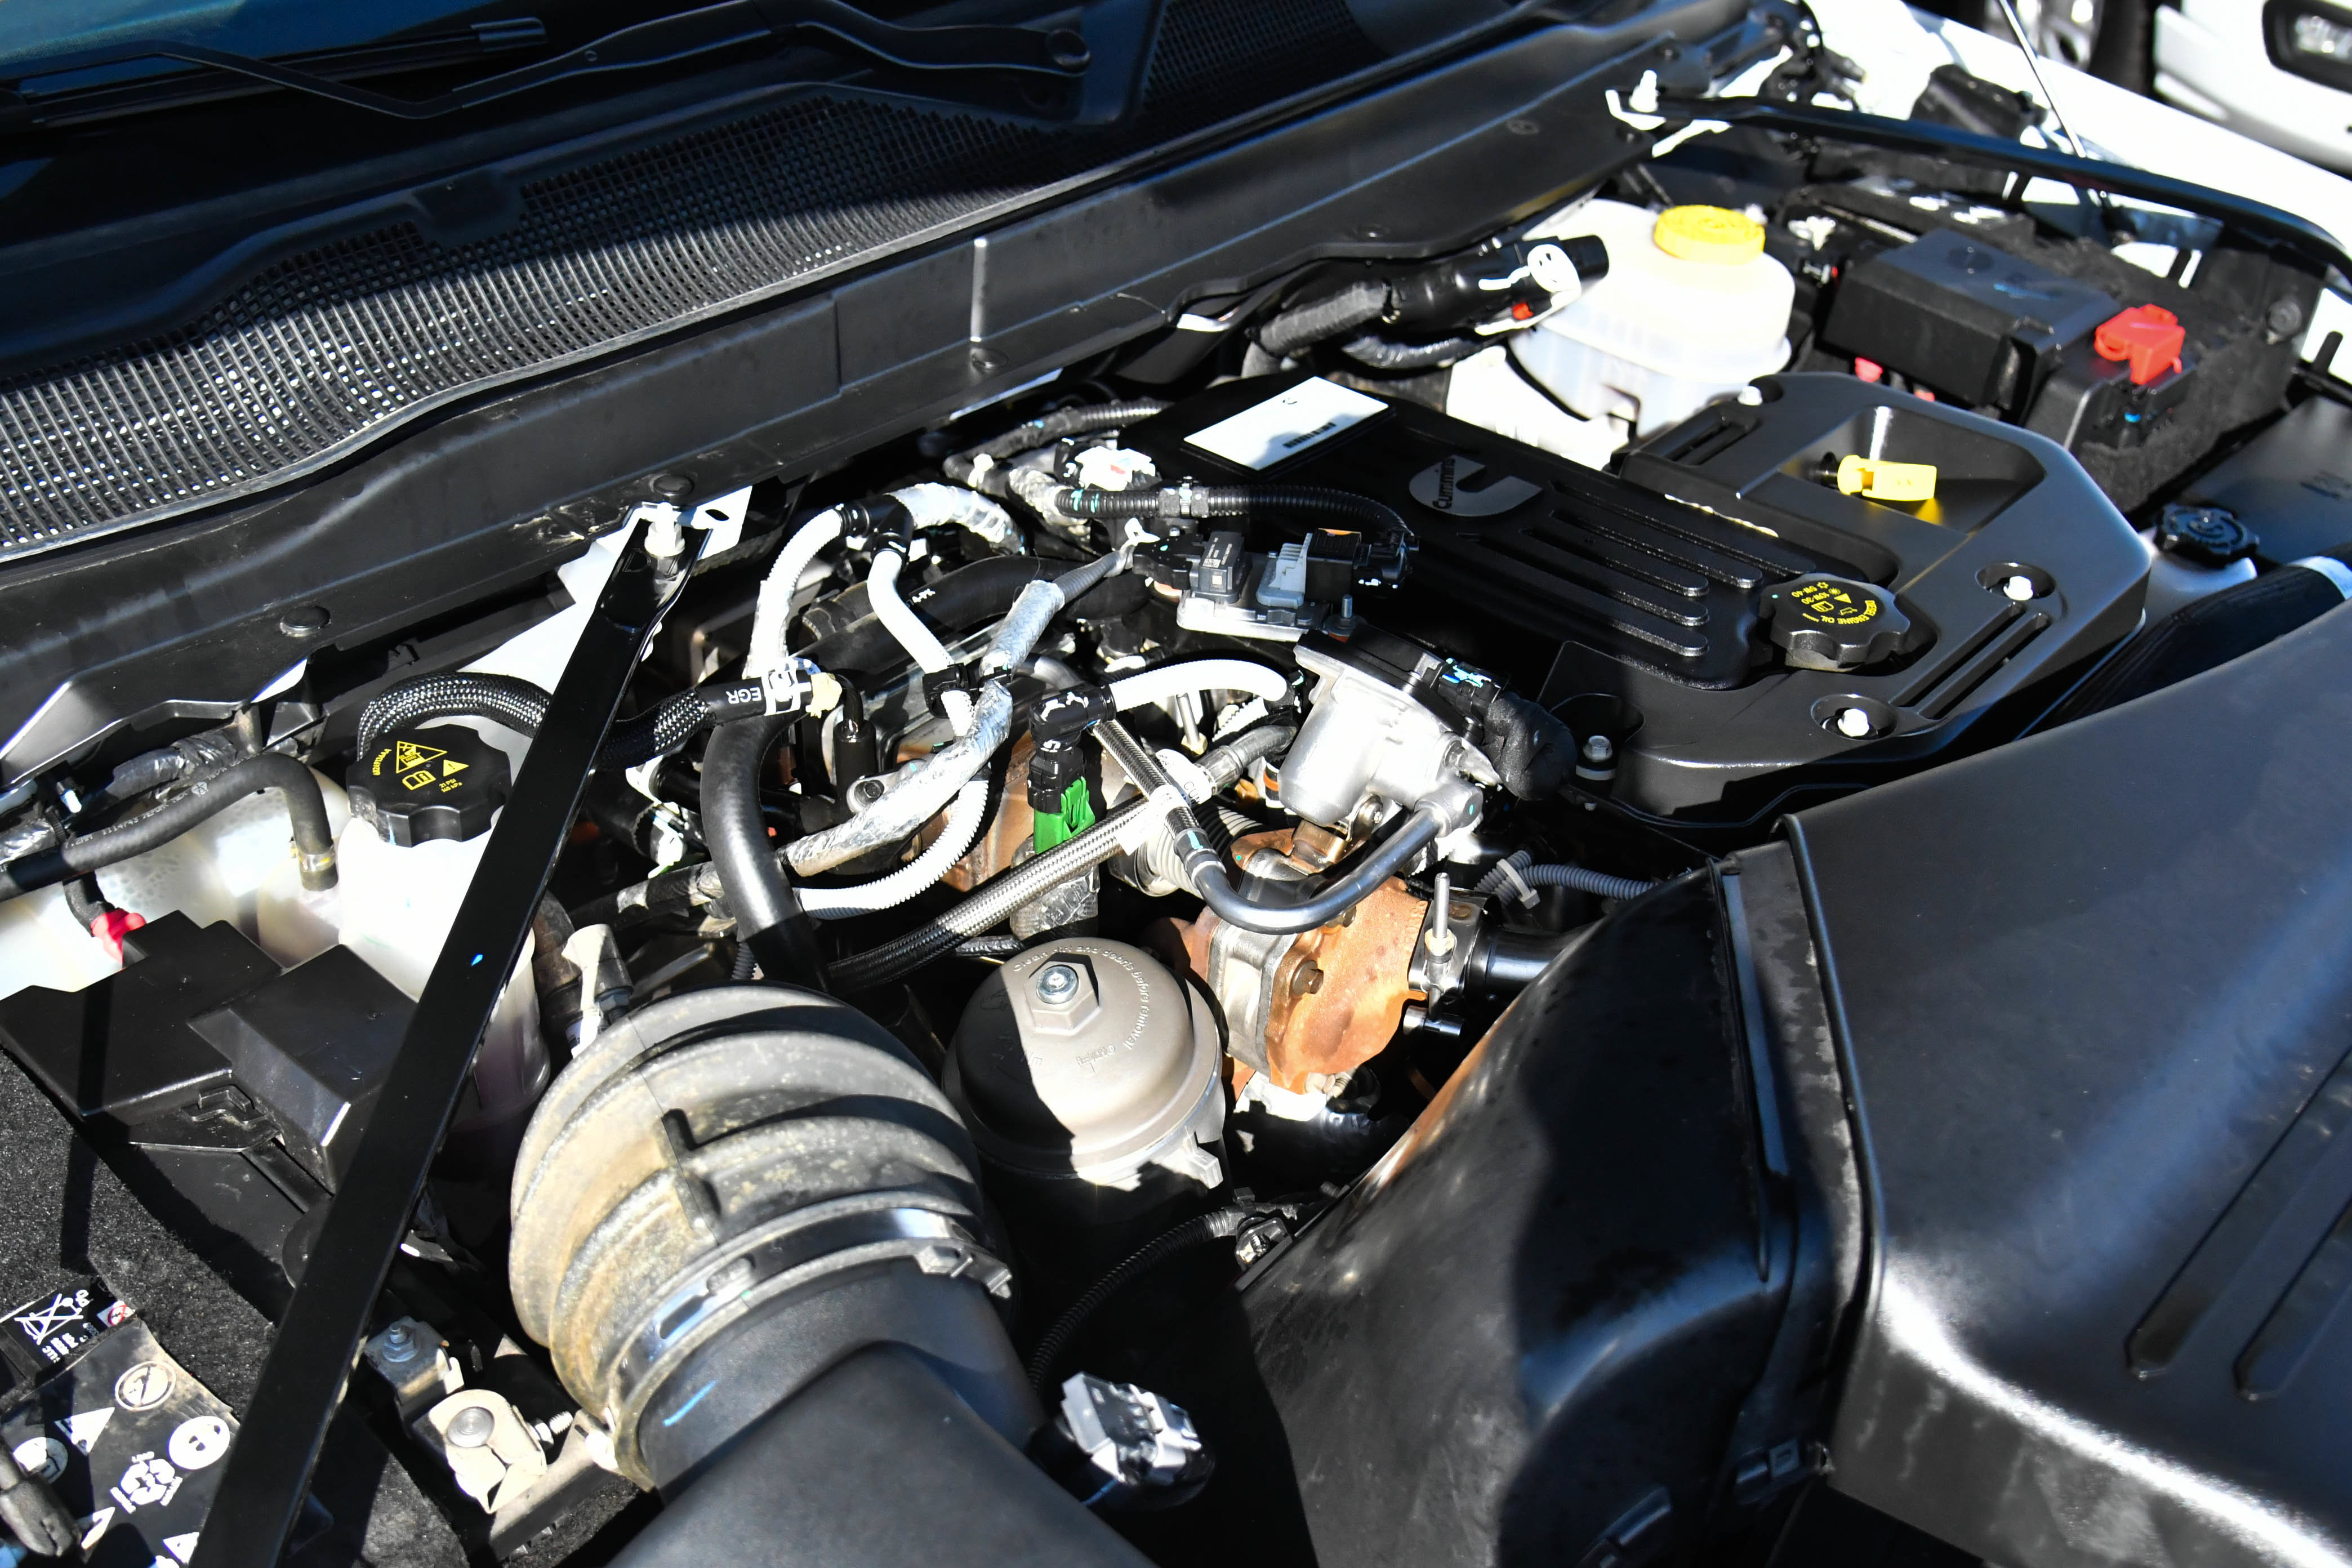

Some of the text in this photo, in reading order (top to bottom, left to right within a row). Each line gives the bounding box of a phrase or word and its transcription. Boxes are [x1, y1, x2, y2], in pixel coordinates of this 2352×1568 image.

[1432, 457, 1455, 509] Cummins
[1820, 615, 1835, 623] OIL
[1837, 614, 1870, 625] ENGINE
[725, 687, 762, 704] EGR
[446, 778, 457, 786] PSI
[450, 781, 463, 790] kPa
[1075, 946, 1102, 955] and
[1013, 951, 1048, 972] Clean
[1102, 948, 1134, 972] debris
[1130, 970, 1150, 1003] before
[1122, 1004, 1150, 1050] removal
